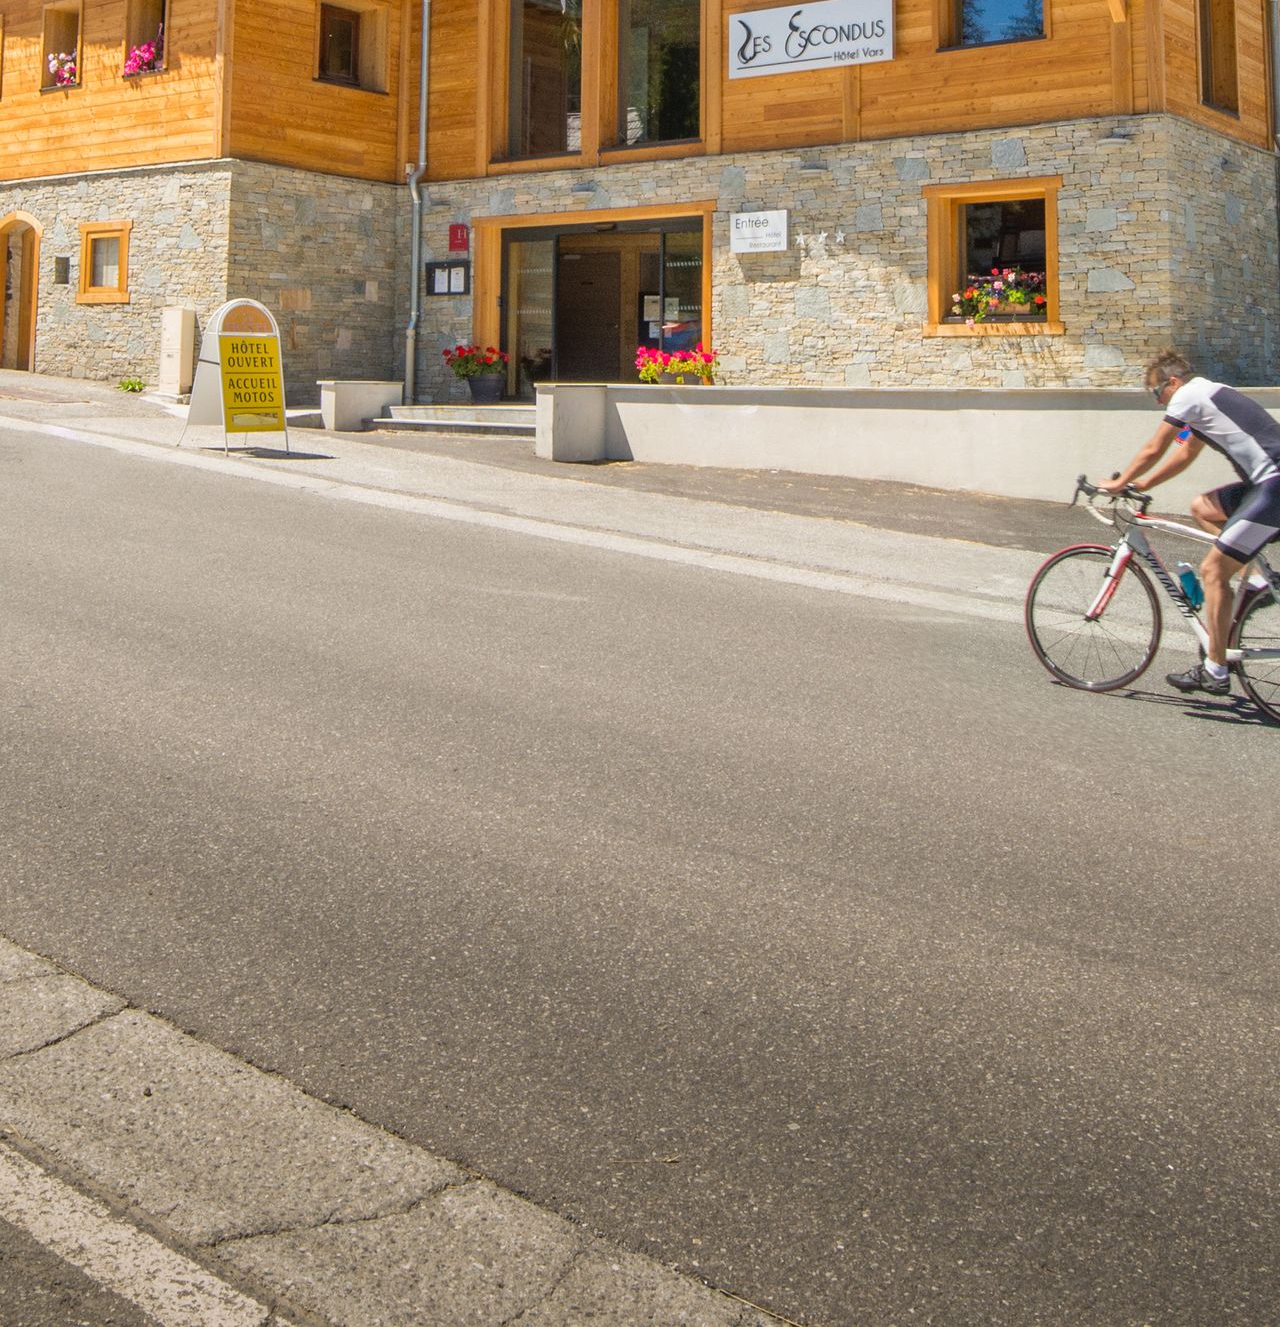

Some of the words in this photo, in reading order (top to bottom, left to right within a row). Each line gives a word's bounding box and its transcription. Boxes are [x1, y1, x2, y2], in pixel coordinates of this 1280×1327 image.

[737, 19, 772, 64] LES
[785, 9, 885, 58] ESCONDUS
[833, 49, 860, 62] Hôtel
[862, 47, 884, 58] Vars
[735, 217, 769, 229] Entrée
[231, 340, 270, 354] HÔTEL
[227, 357, 274, 368] OUVERT
[228, 378, 278, 389] ACCUEIL
[233, 392, 275, 403] MOTOS
